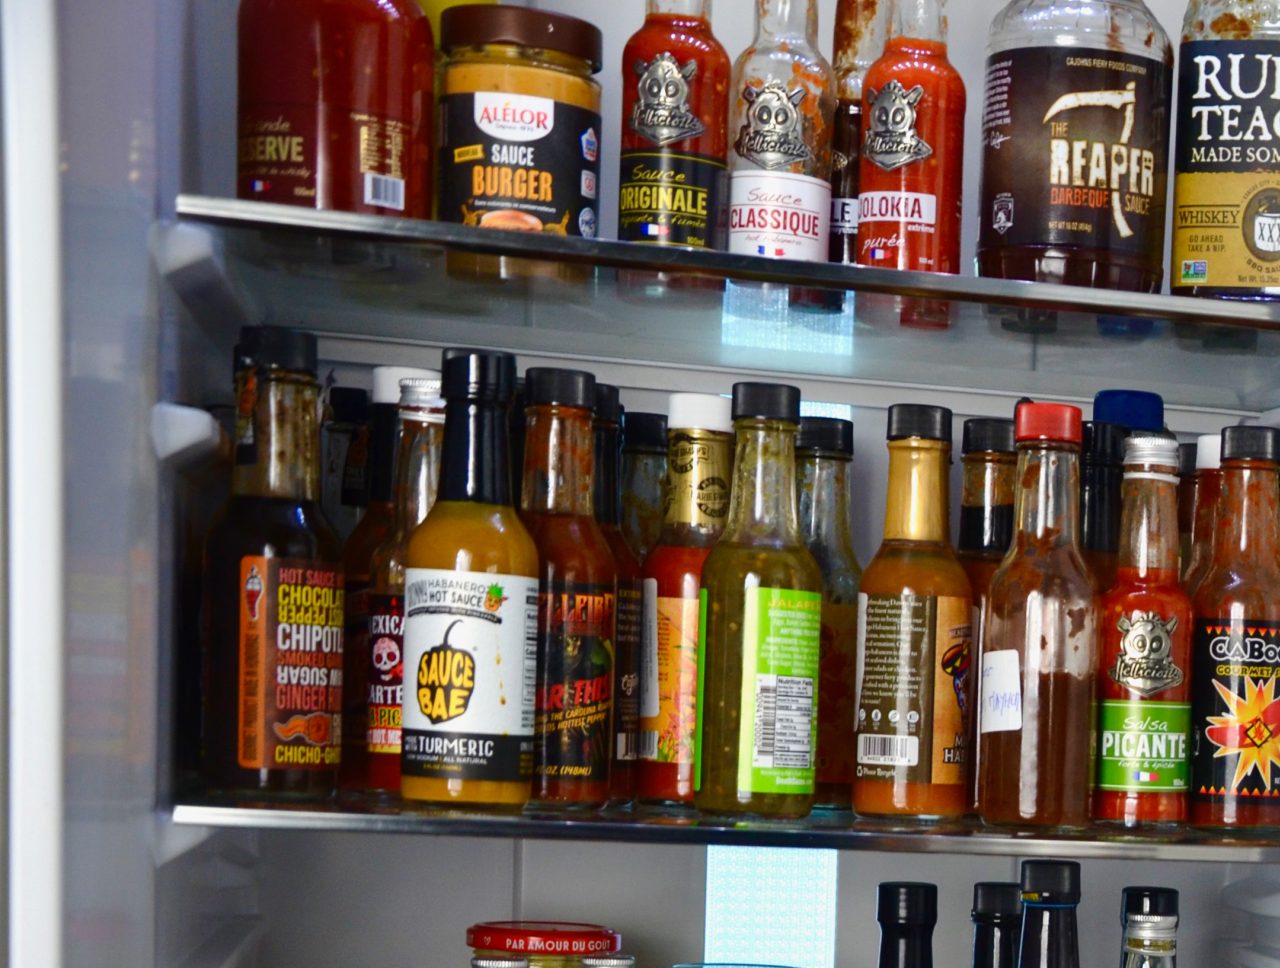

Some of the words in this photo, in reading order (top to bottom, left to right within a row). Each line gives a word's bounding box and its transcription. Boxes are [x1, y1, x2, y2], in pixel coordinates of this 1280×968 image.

[1092, 58, 1107, 68] FIERY
[480, 101, 548, 130] ALÉLOR
[1051, 122, 1068, 136] THE
[492, 144, 535, 166] SAUCE
[1190, 146, 1242, 163] MADE
[632, 164, 686, 182] Sauce
[1050, 138, 1154, 197] REAPER
[472, 165, 552, 202] BURGER
[621, 186, 708, 215] ORIGINALE
[747, 188, 802, 206] Sauce
[1050, 187, 1109, 208] BARBEQUE
[1125, 194, 1149, 215] SAUCE
[859, 196, 923, 219] JOLOKIA
[730, 207, 819, 236] CLASSIQUE
[1178, 209, 1240, 226] WHISKEY
[863, 233, 905, 254] purée
[1188, 244, 1203, 252] TAKE
[1200, 235, 1224, 243] AHEAD
[279, 567, 303, 584] HOT
[306, 569, 335, 586] SAUCE
[428, 579, 486, 594] HABANERO
[429, 590, 447, 604] HOT
[451, 592, 483, 608] SAUCE
[277, 606, 328, 626] PEPPER
[277, 652, 325, 666] SMOKED
[277, 665, 328, 686] SUGAR
[418, 650, 474, 688] SAUCE
[1216, 664, 1273, 678] GOURMET
[276, 685, 326, 710] GINGER
[369, 685, 403, 704] ARTE
[418, 687, 469, 721] BAE
[1123, 716, 1168, 731] Salsa
[418, 735, 494, 757] TURMERIC
[1102, 732, 1186, 759] PICANTE
[456, 756, 488, 765] NATURAL
[506, 938, 525, 950] PAR
[527, 939, 569, 951] AMOUR
[572, 940, 586, 951] DU
